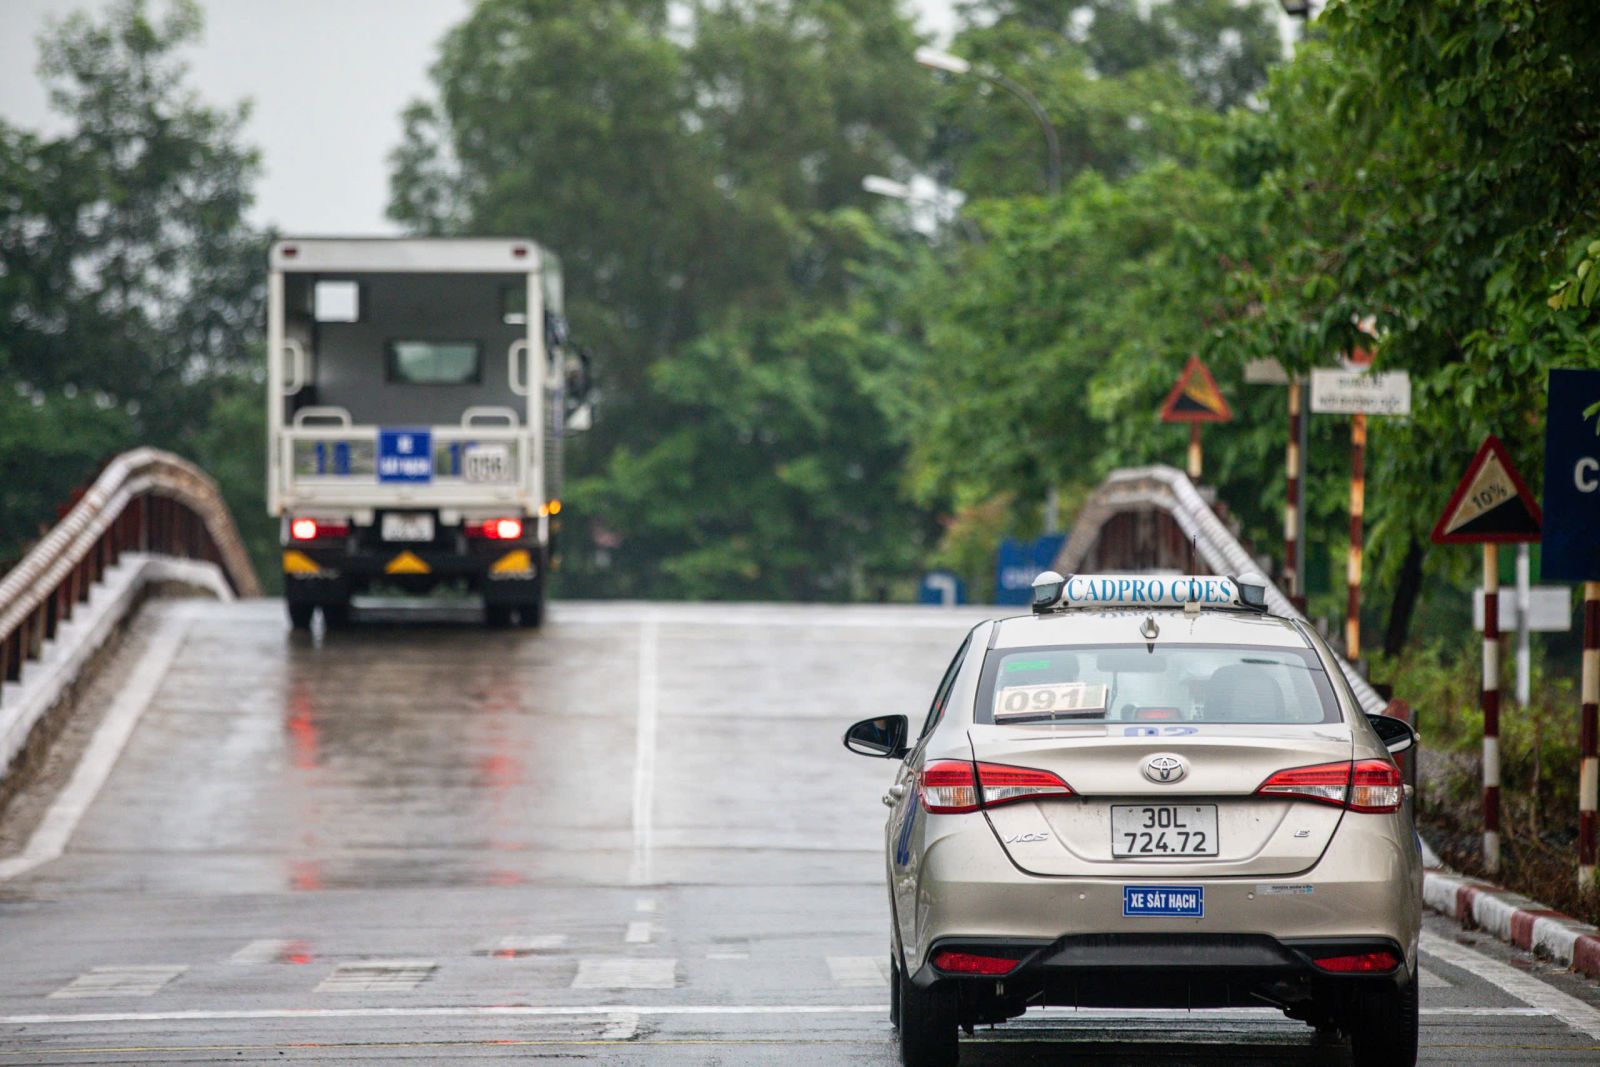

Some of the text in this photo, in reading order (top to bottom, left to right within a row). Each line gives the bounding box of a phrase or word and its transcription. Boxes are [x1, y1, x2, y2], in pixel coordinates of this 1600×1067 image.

[1472, 481, 1508, 509] 10%
[1067, 579, 1231, 603] CADPRO CDES
[1004, 688, 1080, 712] 091
[1142, 807, 1187, 829] 30L
[1123, 832, 1207, 854] 724.72
[1130, 890, 1197, 911] XE SÁT HẠCH
